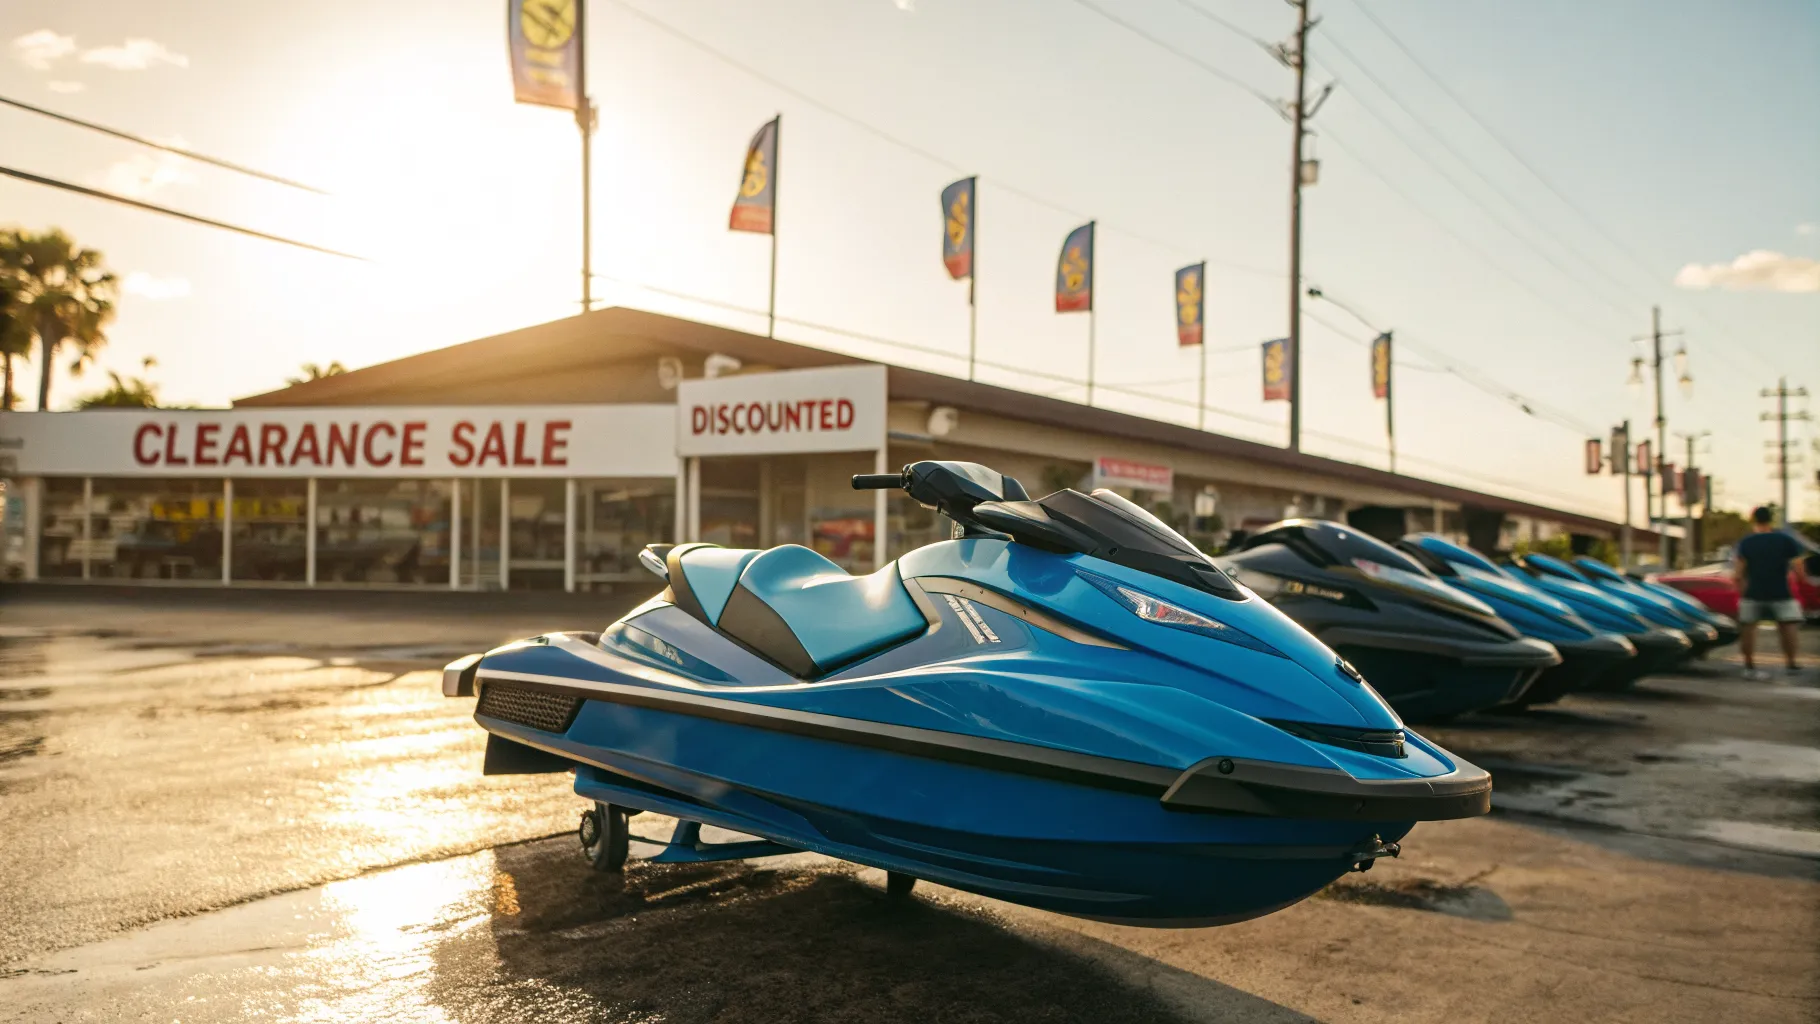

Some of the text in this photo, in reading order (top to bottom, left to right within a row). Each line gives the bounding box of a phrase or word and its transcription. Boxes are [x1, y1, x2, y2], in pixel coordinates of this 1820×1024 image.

[692, 398, 855, 435] DISCOUNTED
[134, 419, 572, 467] CLEARANCE SALE
